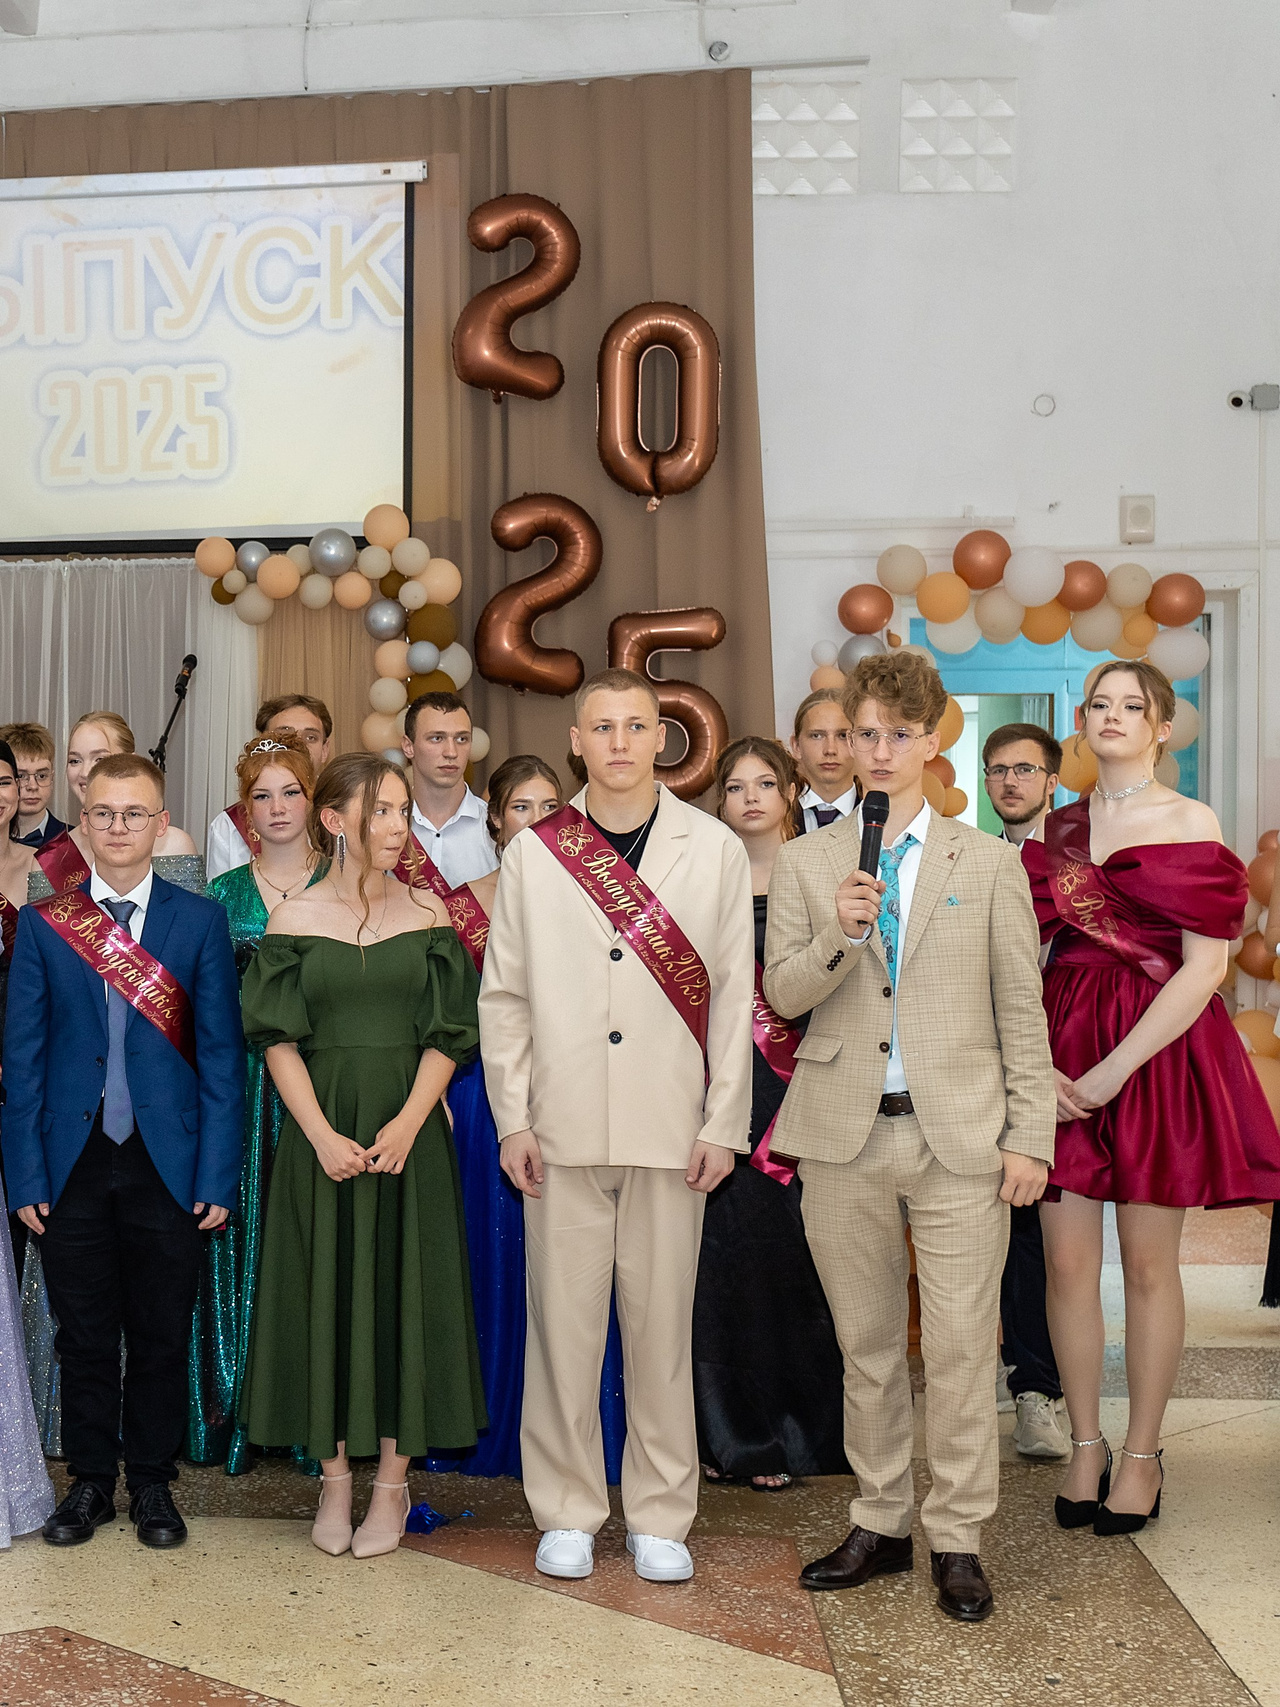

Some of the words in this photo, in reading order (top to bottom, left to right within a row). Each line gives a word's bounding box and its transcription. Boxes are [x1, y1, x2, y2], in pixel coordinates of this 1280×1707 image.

[452, 193, 581, 402] 2
[40, 363, 230, 484] 2025
[474, 492, 603, 696] 2
[70, 910, 170, 1009] Выпускник
[581, 848, 675, 960] Выпускник
[663, 951, 711, 1006] 2025
[649, 903, 671, 932] Сергей
